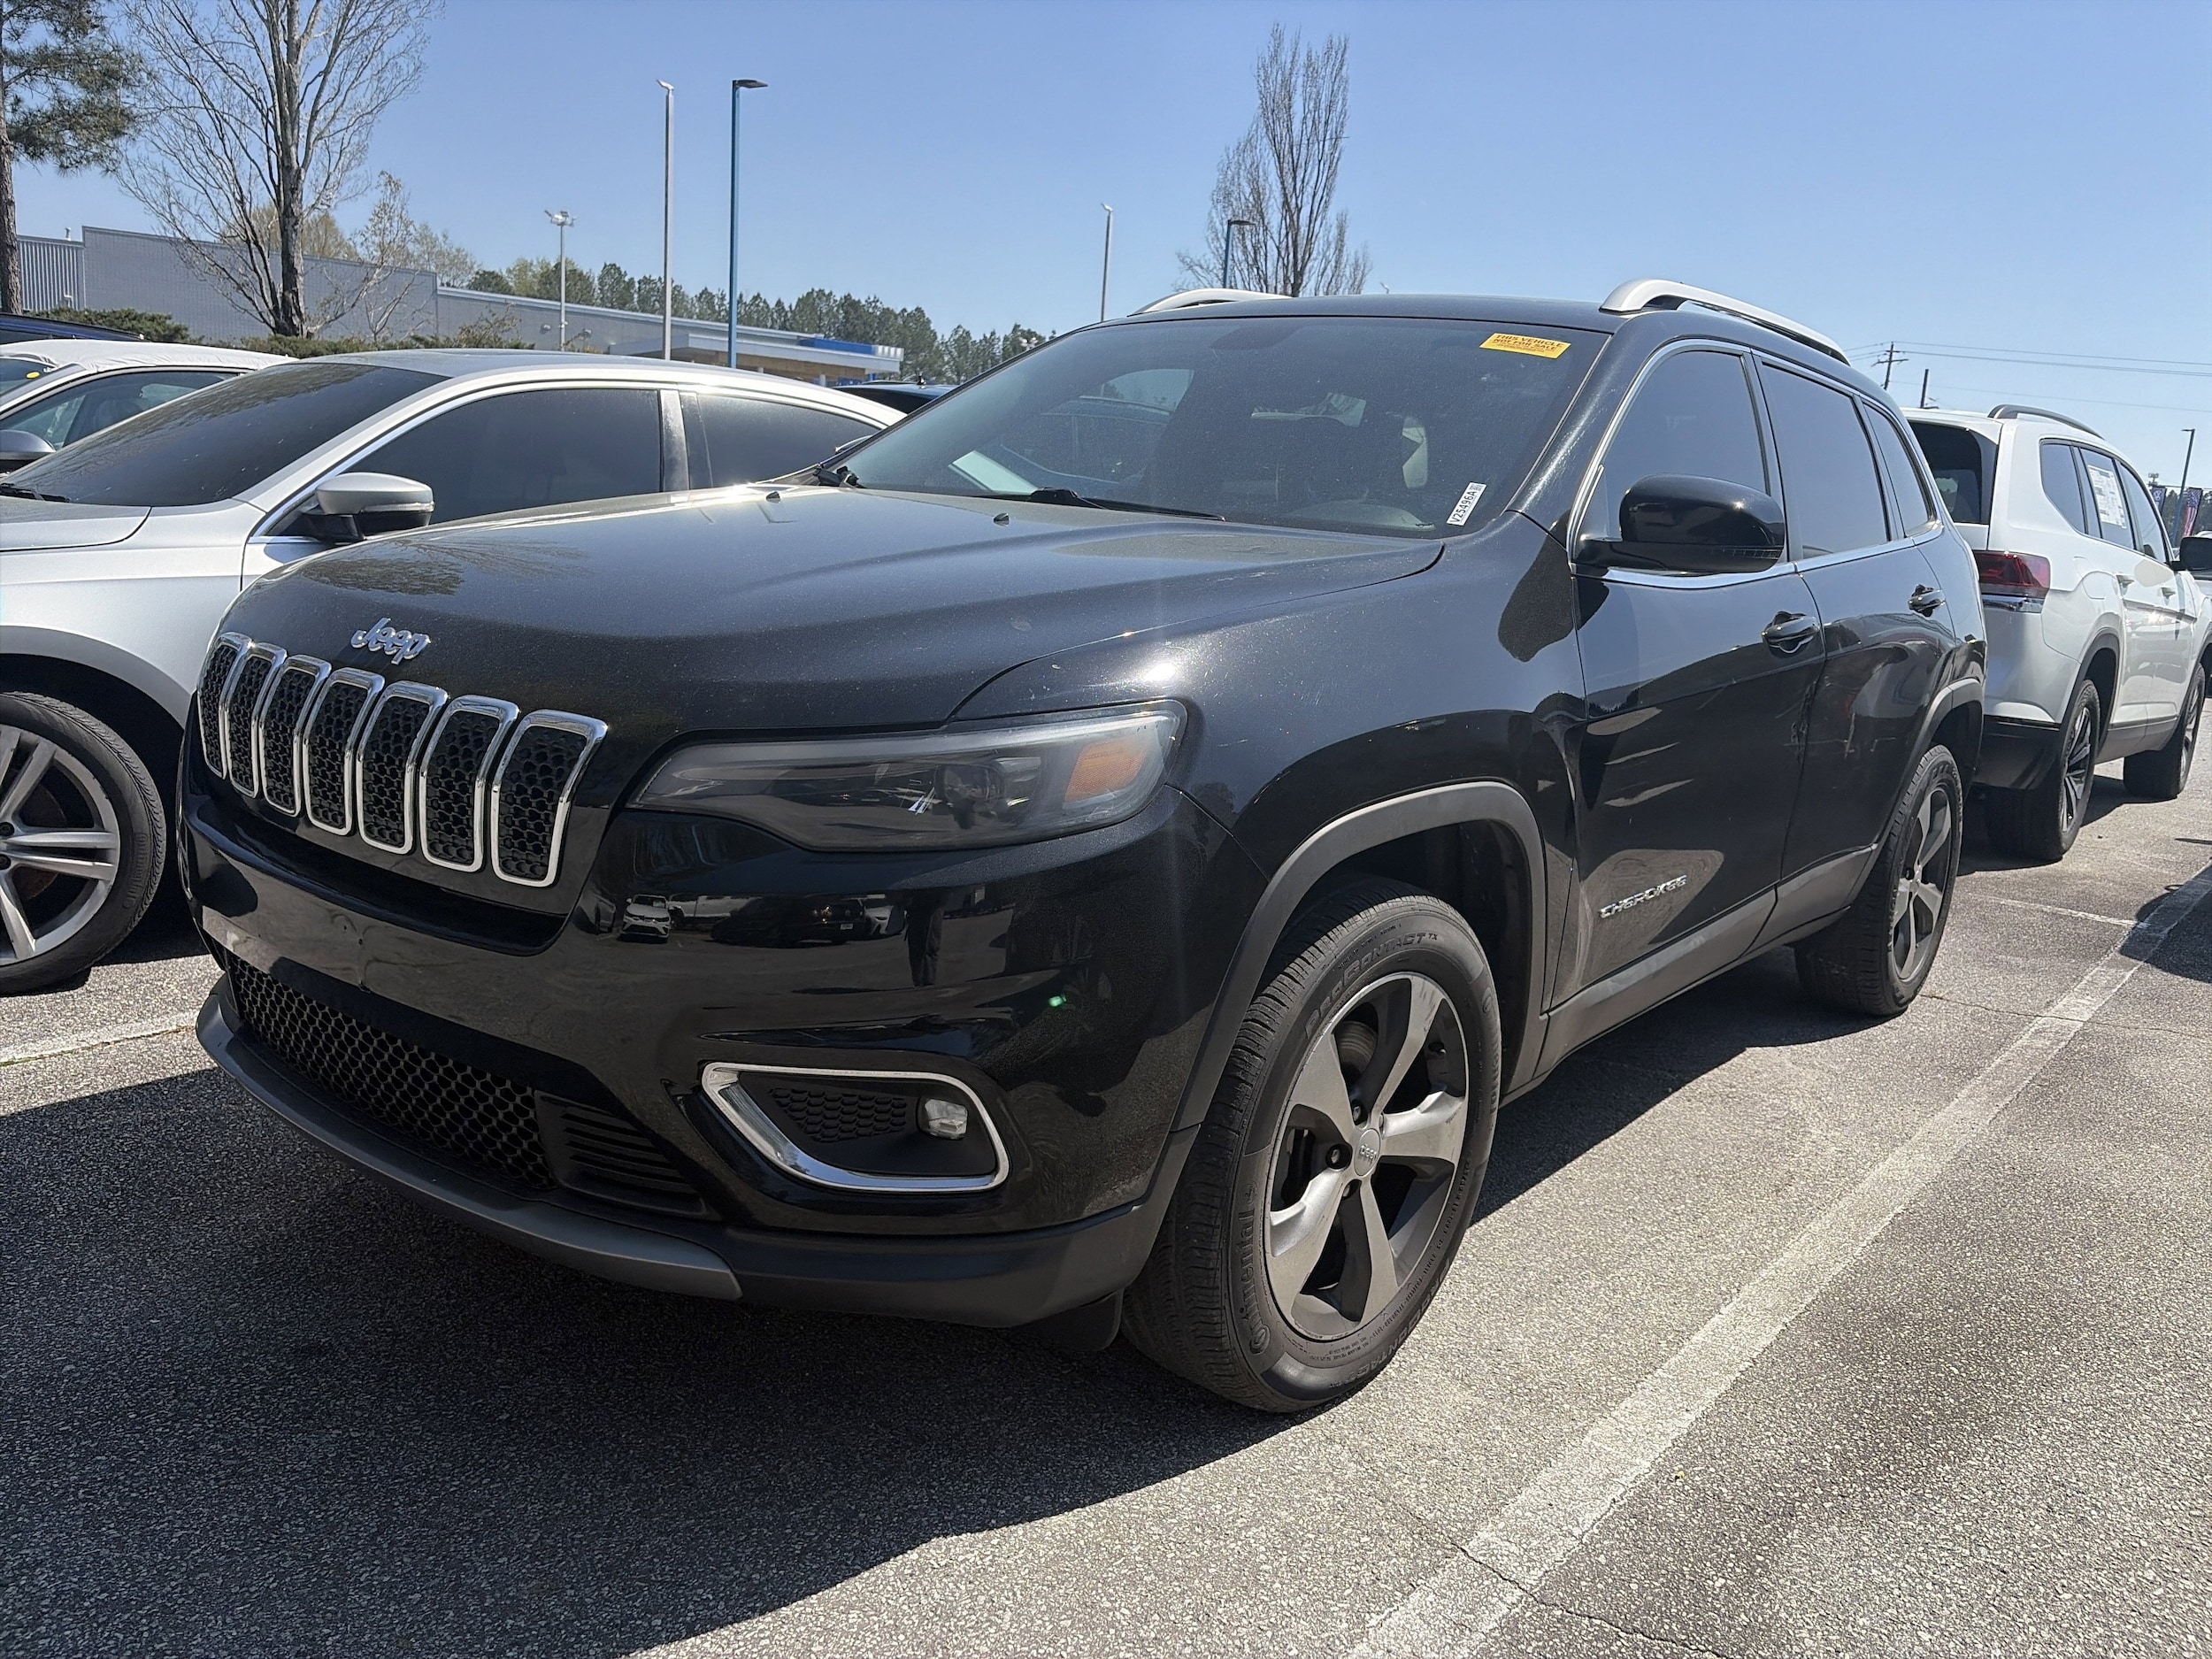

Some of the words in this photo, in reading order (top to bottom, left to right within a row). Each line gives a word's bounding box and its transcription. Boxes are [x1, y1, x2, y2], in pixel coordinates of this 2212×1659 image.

[1521, 337, 1564, 347] VEHICLE
[1449, 491, 1477, 522] V25496A
[350, 618, 432, 665] Jeep
[1599, 874, 1687, 918] CHEROKEE
